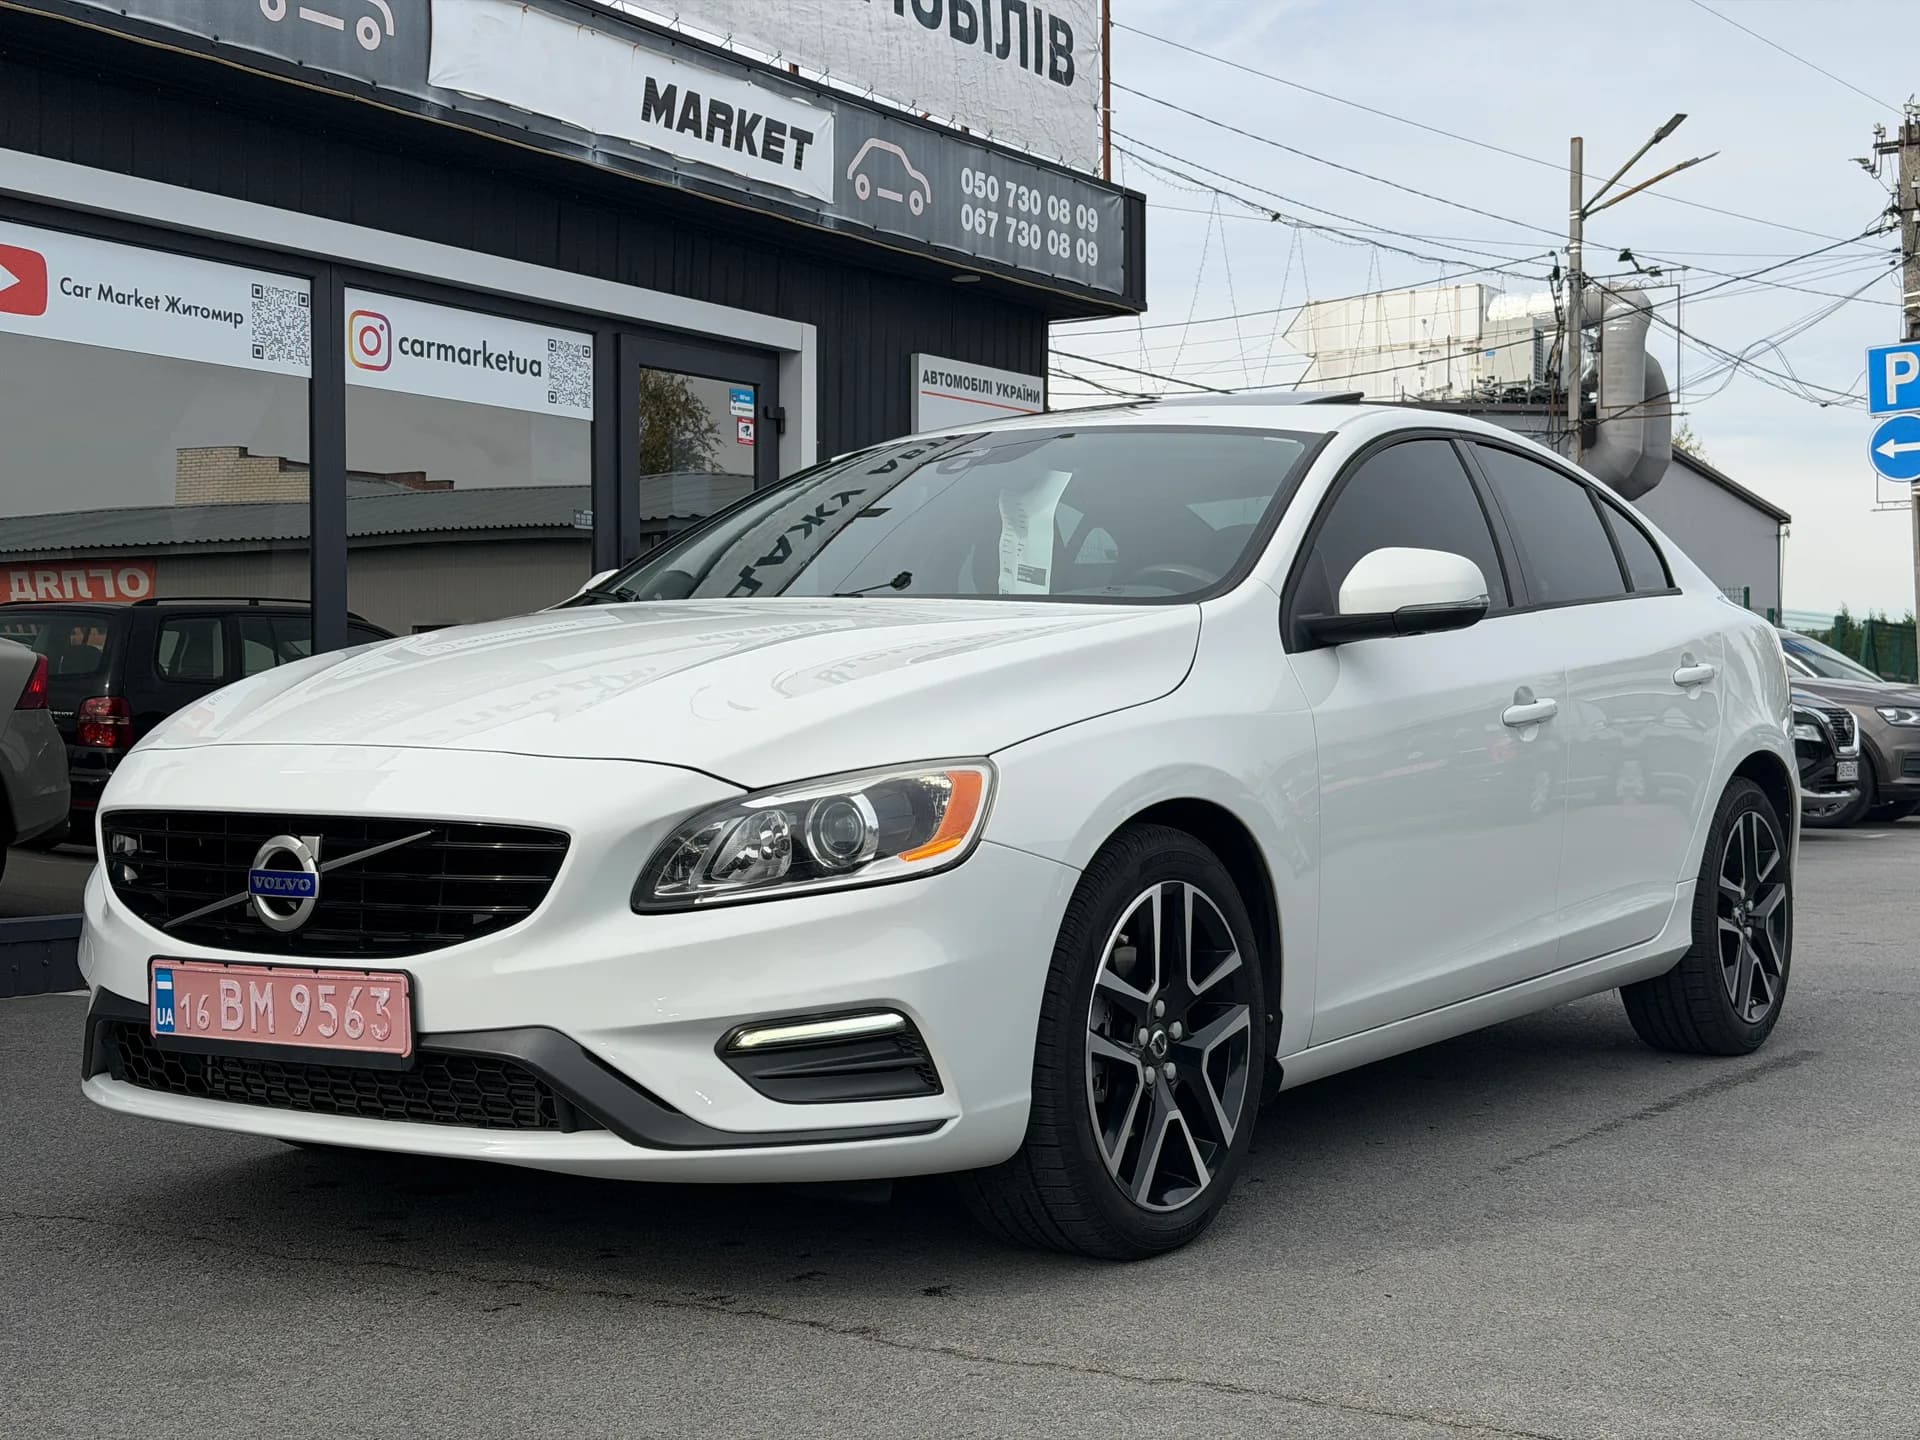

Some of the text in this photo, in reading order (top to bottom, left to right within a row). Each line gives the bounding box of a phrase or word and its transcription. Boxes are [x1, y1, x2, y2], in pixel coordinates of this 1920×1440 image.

[641, 76, 814, 171] MARKET
[961, 167, 1098, 233] 050 730 08 09
[961, 203, 1098, 266] 067 730 08 09
[60, 277, 244, 329] Car Market Житомир
[398, 336, 542, 377] carmarketua
[1885, 351, 1919, 405] P
[922, 369, 1041, 405] АВТОМОБІЛІ УКРАЇНИ
[252, 875, 311, 891] VOLVO
[157, 1007, 175, 1026] UA
[180, 992, 210, 1030] 16
[290, 984, 392, 1042] 9563
